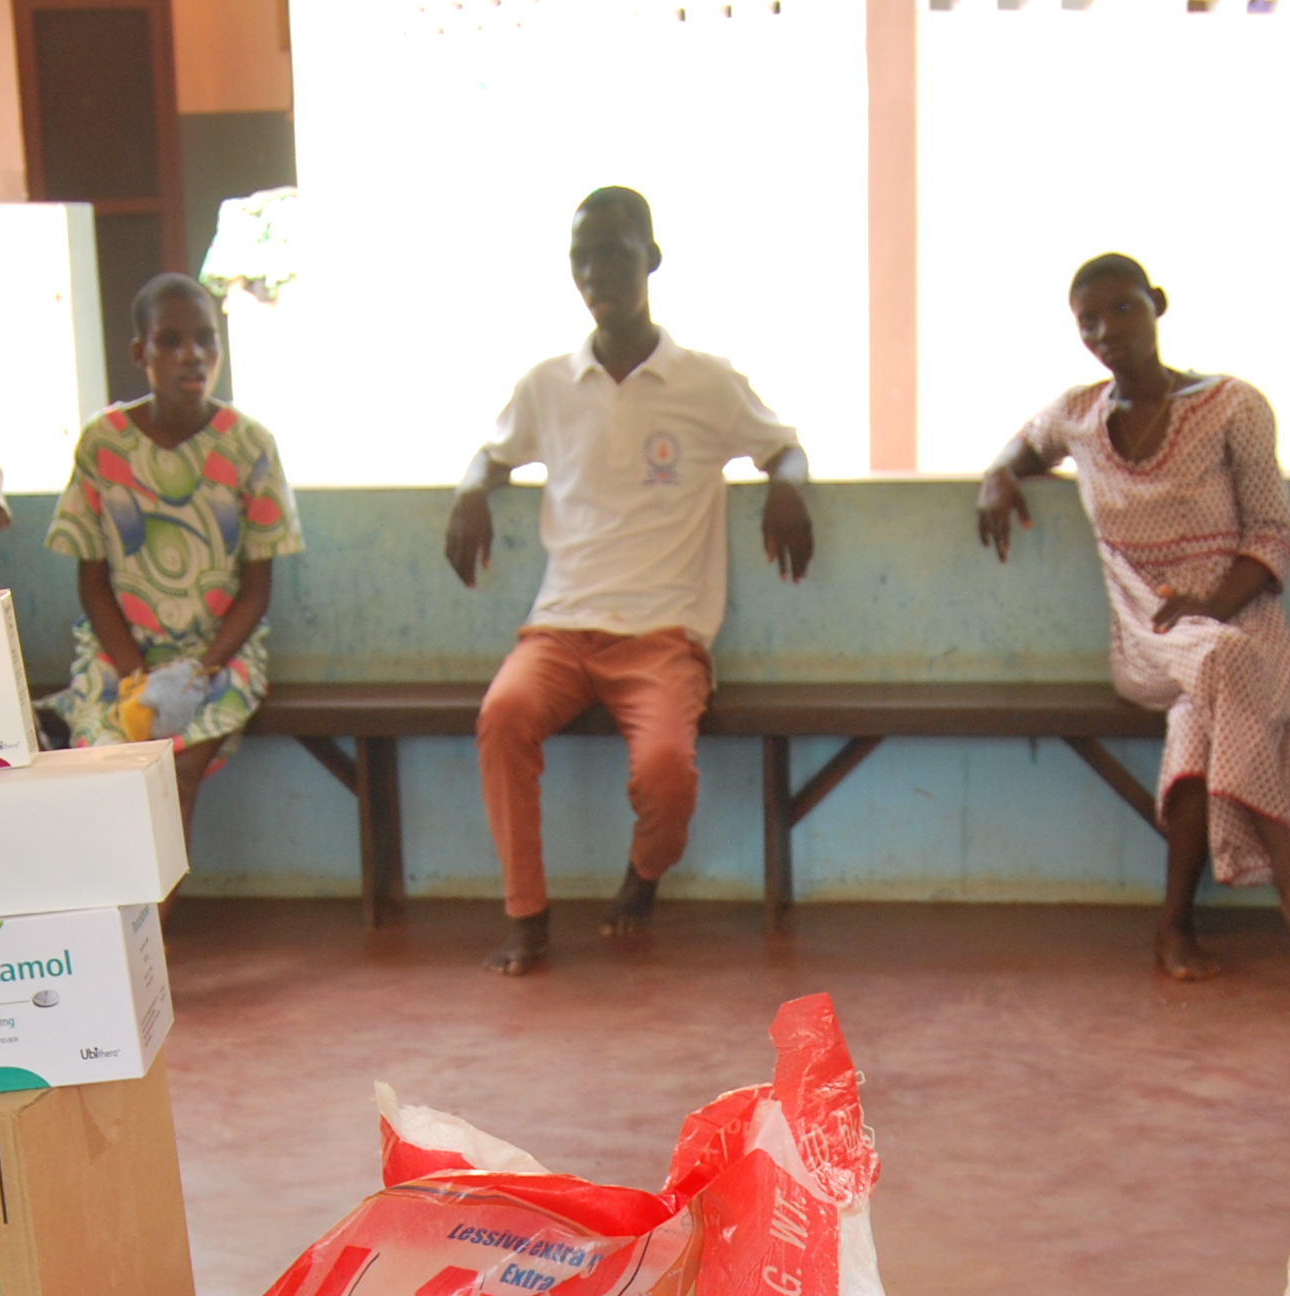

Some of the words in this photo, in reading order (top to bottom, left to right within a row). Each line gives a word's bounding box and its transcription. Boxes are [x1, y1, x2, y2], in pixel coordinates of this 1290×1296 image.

[0, 1016, 15, 1030] mg
[447, 1223, 527, 1254] Lessive
[529, 1238, 585, 1267] extra
[499, 1262, 557, 1292] Extra
